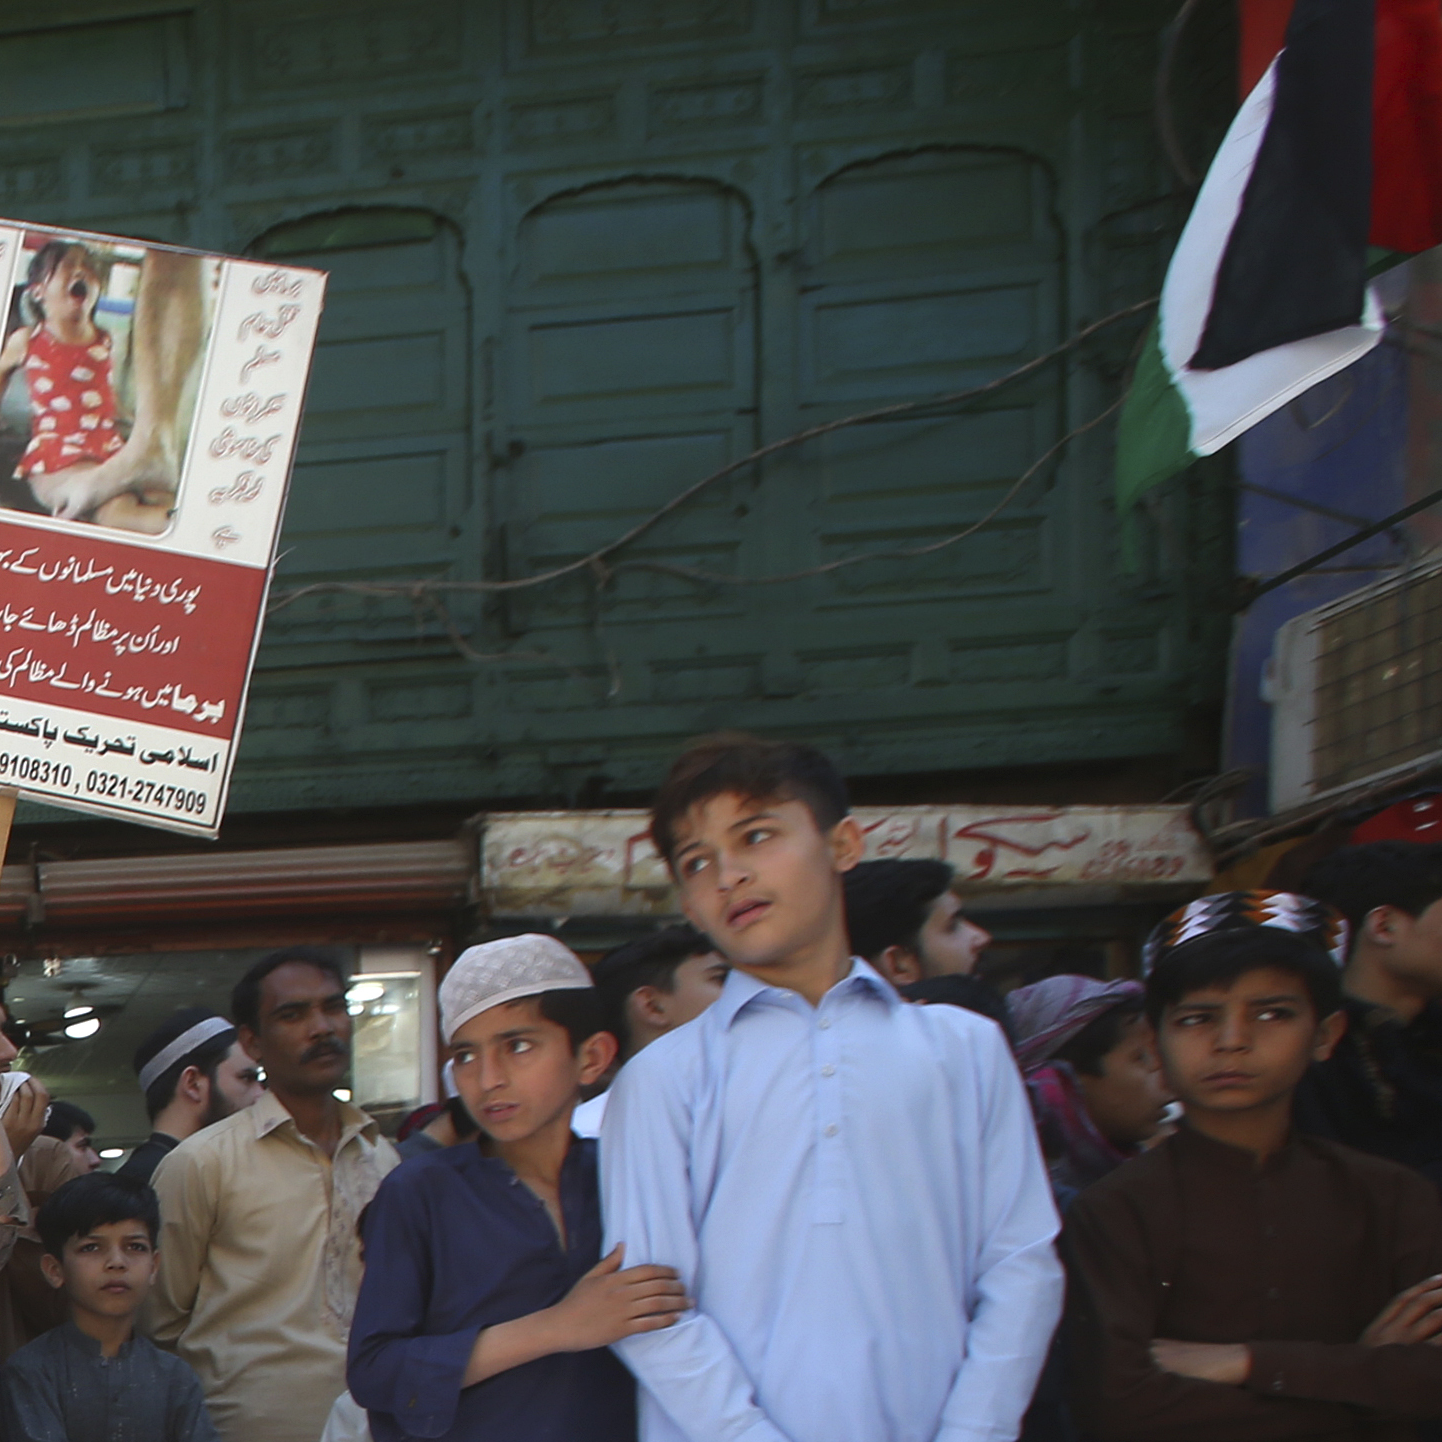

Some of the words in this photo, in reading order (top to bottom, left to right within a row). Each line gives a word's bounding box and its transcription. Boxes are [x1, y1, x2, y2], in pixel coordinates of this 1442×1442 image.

[8, 546, 40, 574] کے
[38, 556, 113, 583] مسلمانوں
[106, 568, 137, 594] میں
[135, 572, 159, 601] دنیا
[159, 577, 202, 615] پوری
[72, 608, 118, 648] مظالم
[112, 630, 130, 656] پر
[9, 648, 56, 689] مظالم
[50, 662, 96, 692] والے
[95, 671, 144, 700] ہونے
[141, 683, 172, 709] میں
[171, 684, 226, 724] برما
[63, 725, 136, 756] تحریک
[139, 745, 219, 774] اسلامی
[86, 769, 207, 815] 0321-2747909
